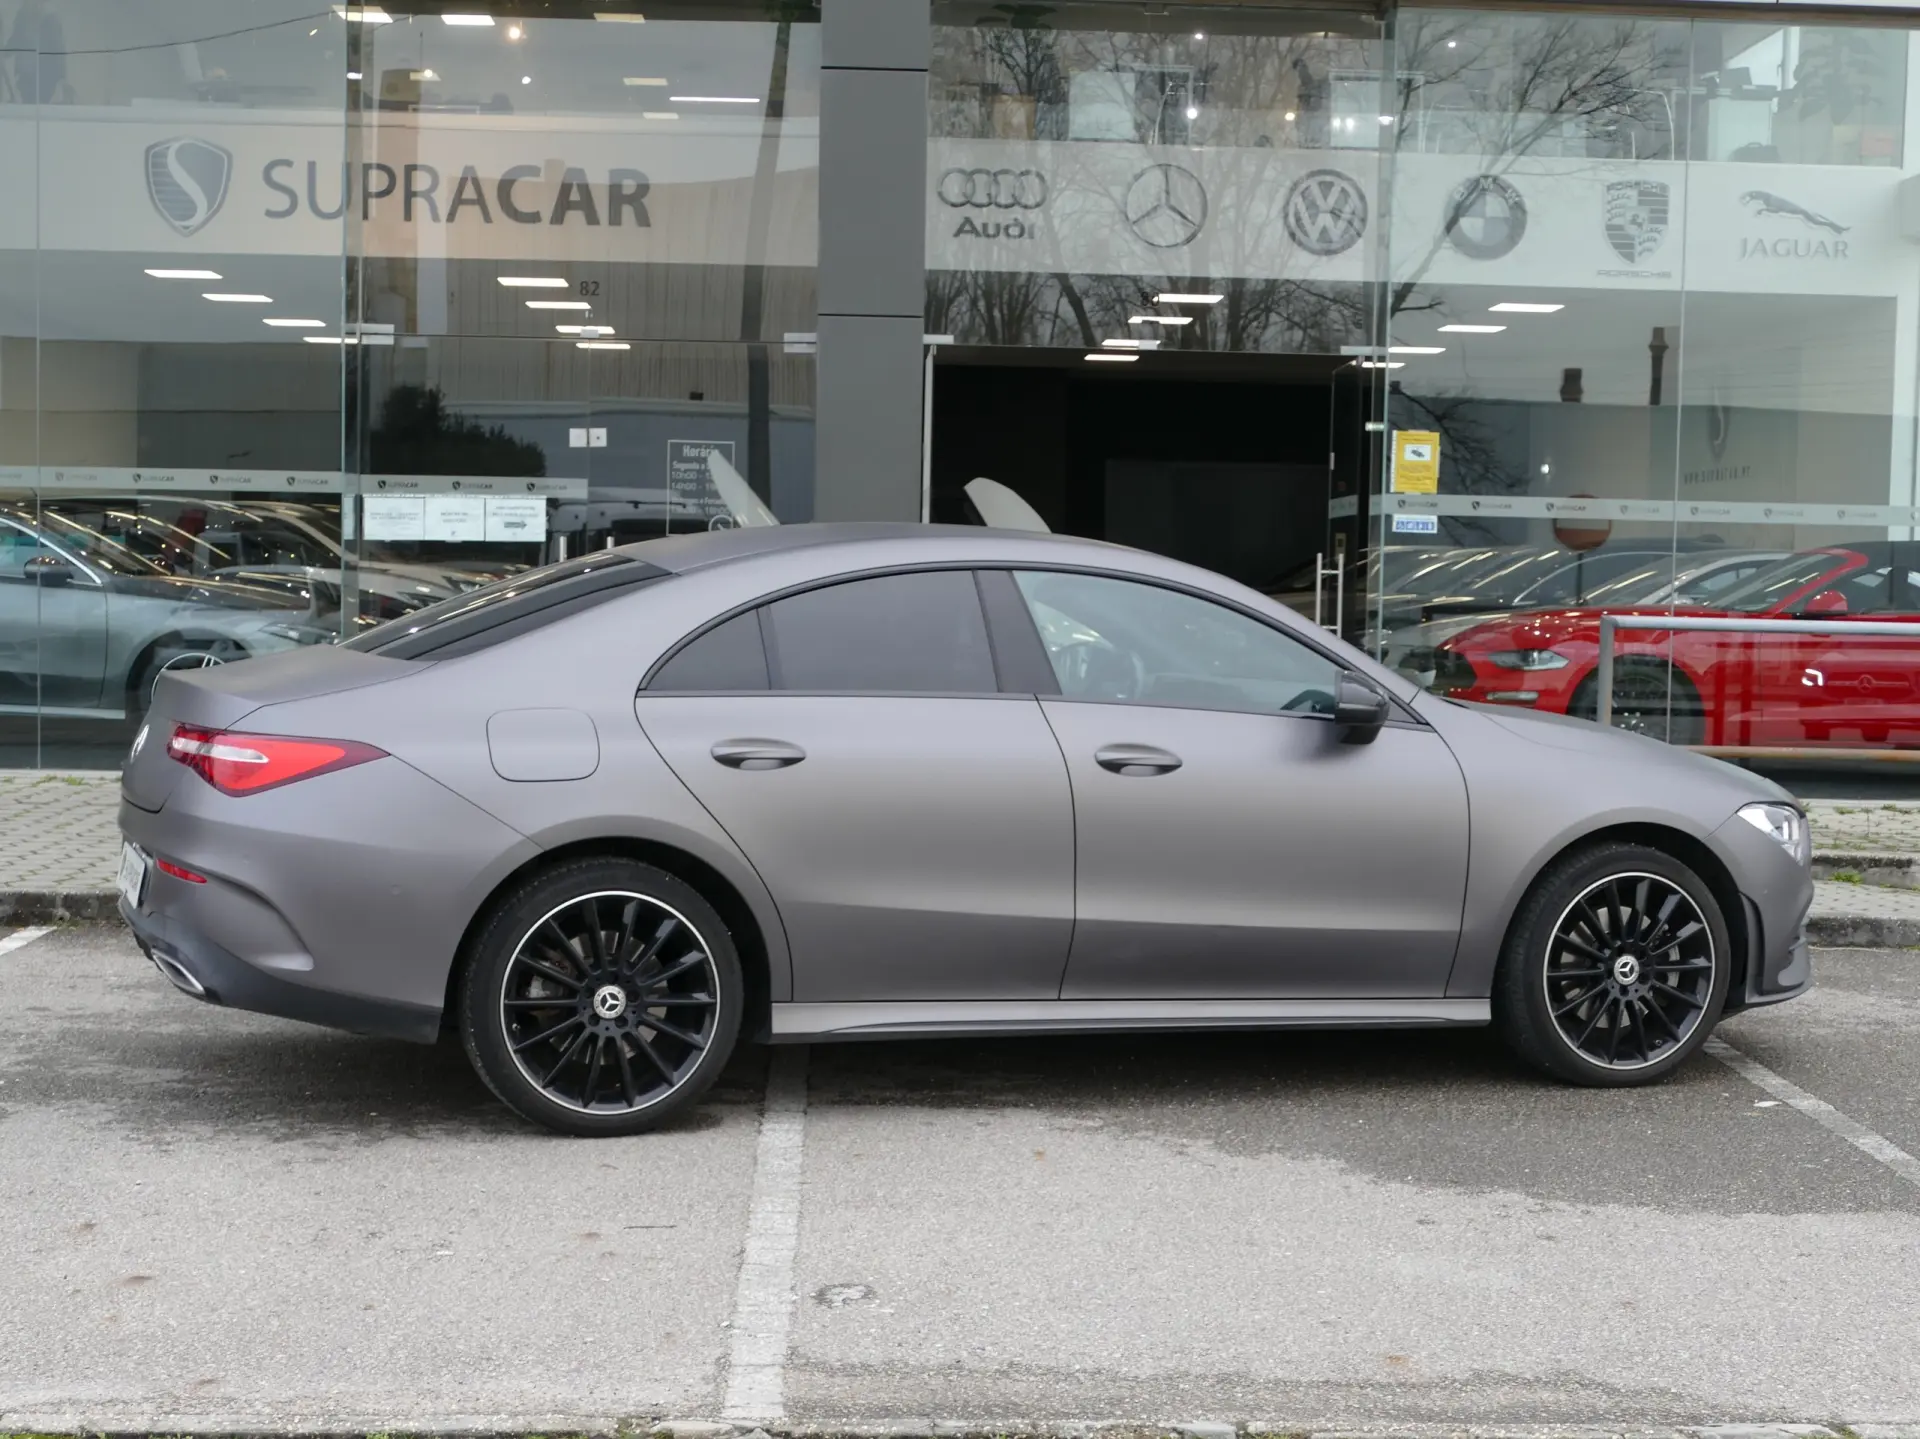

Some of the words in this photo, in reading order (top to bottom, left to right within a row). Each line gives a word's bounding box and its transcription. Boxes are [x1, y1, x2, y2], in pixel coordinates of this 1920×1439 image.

[262, 158, 651, 227] SUPRACAR
[952, 216, 1035, 239] Audi
[1738, 237, 1849, 260] JAGUAR
[1597, 269, 1672, 279] PORSCHE
[579, 280, 600, 296] 82
